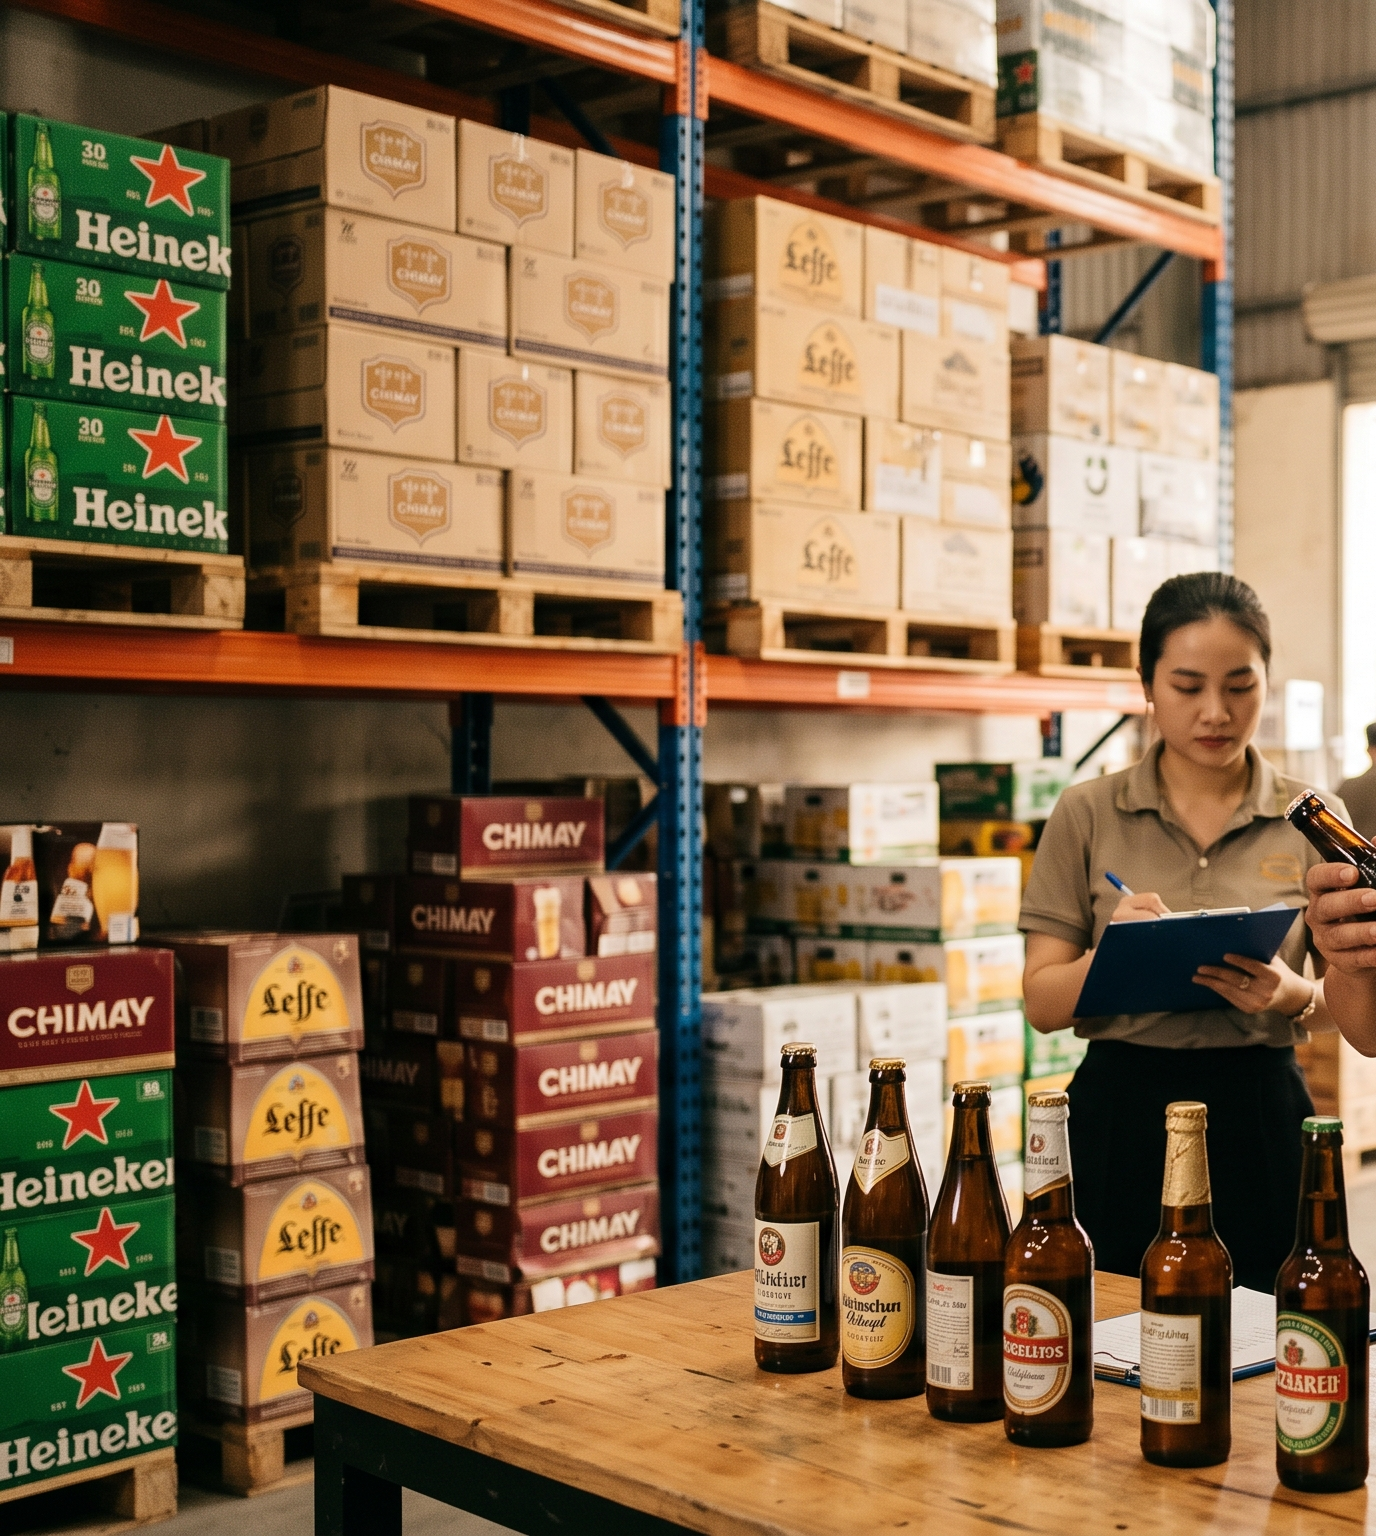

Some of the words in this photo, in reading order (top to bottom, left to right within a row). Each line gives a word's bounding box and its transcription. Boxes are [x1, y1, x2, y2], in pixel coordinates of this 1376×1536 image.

[82, 140, 106, 161] 30
[76, 209, 231, 277] Heinek
[784, 240, 838, 285] Leffe
[76, 277, 101, 297] 30
[69, 345, 226, 406] Heinek
[78, 416, 103, 436] 30
[73, 487, 228, 540] Heinek
[482, 821, 587, 850] CHIMAY
[411, 905, 496, 934] CHIMAY
[8, 996, 155, 1038] CHIMAY
[260, 980, 328, 1022] Leffe
[535, 978, 639, 1015] CHIMAY
[538, 1056, 643, 1097] CHIMAY
[263, 1099, 331, 1141] Leffe
[537, 1135, 642, 1178] CHIMAY
[275, 1215, 341, 1257] Leffe
[540, 1209, 640, 1253] CHIMAY
[0, 1410, 177, 1481] Heineke
